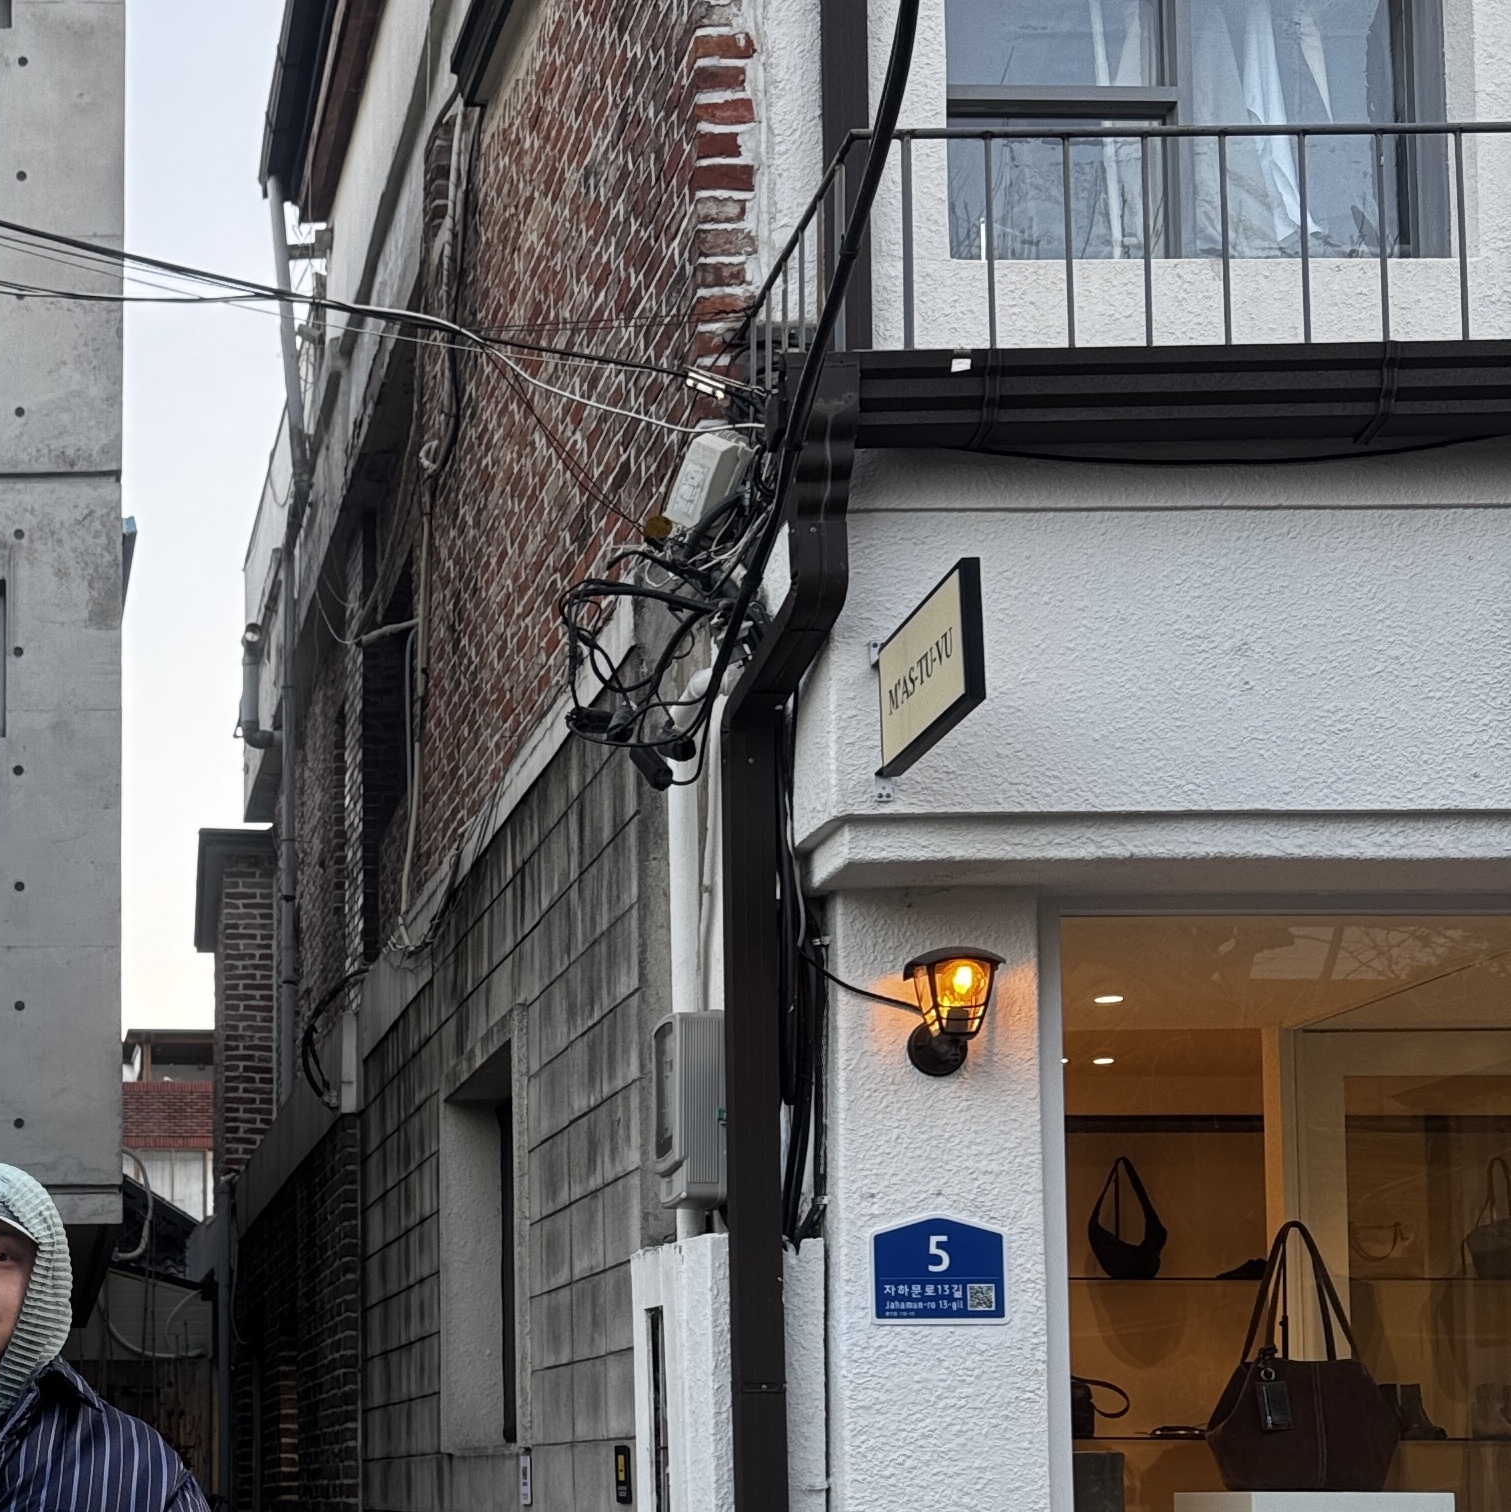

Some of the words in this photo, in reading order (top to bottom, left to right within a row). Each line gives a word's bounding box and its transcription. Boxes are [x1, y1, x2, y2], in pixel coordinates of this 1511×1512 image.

[888, 626, 954, 717] M'AS-TU-VU
[927, 1234, 951, 1273] 5
[883, 1283, 964, 1299] 자하문로13길
[884, 1299, 937, 1310] Jahamun-ro
